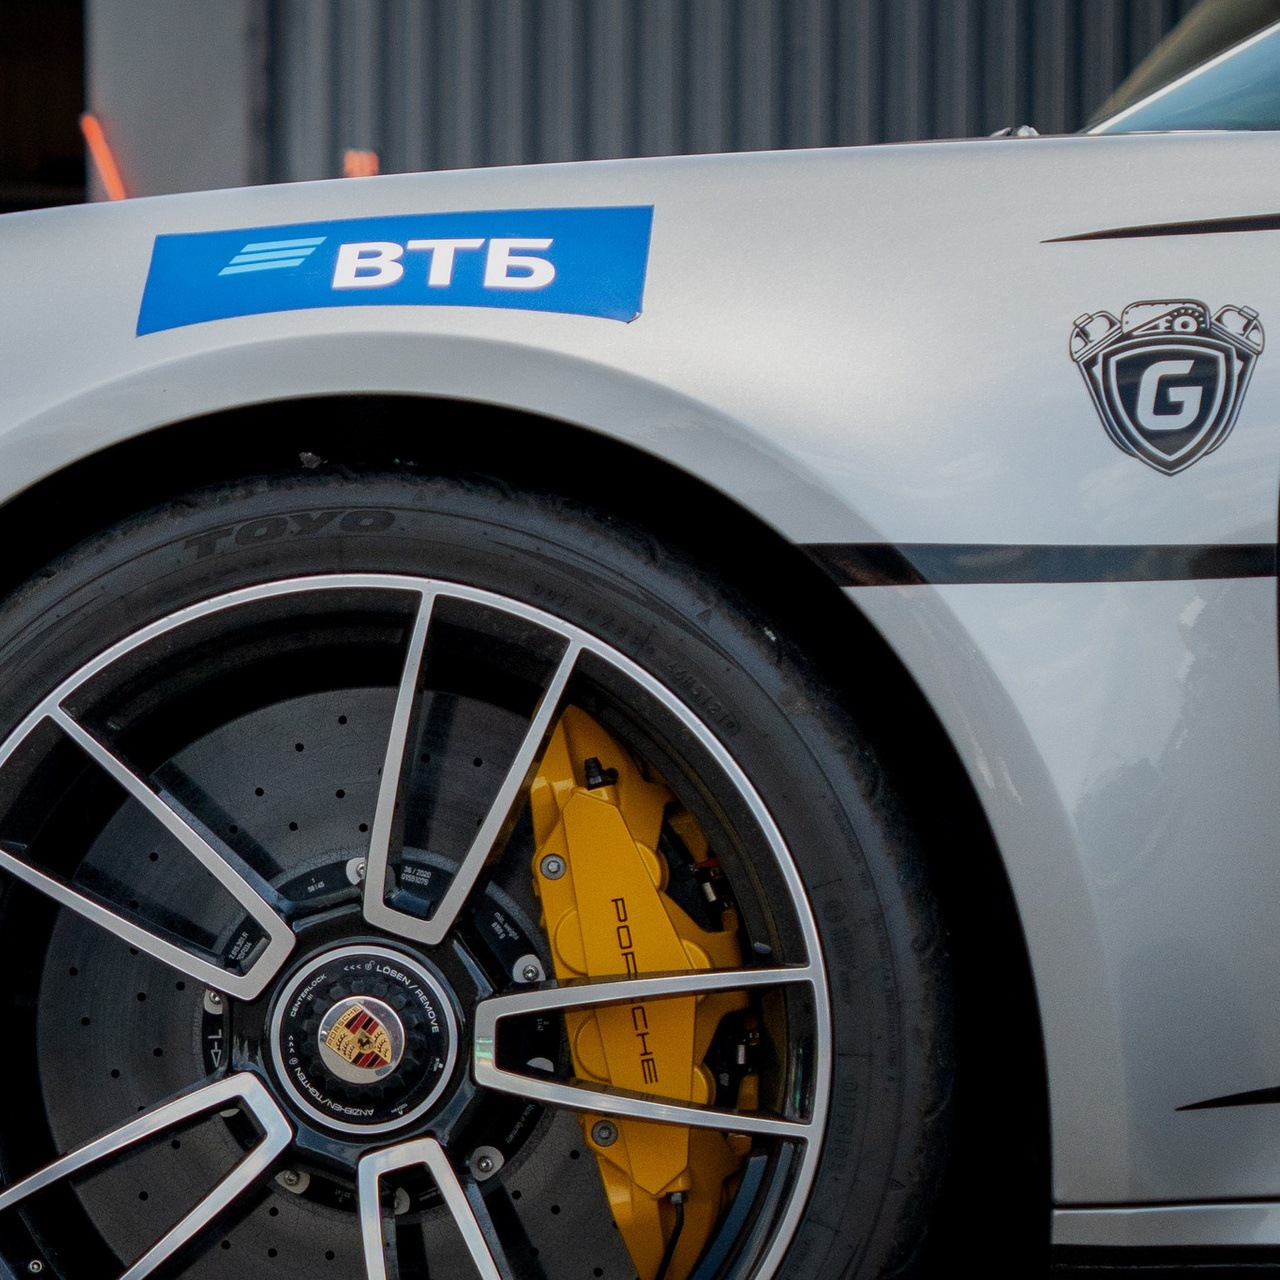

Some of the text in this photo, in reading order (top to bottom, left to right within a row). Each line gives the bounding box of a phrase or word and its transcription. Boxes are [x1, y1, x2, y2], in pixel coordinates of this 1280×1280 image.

[332, 238, 556, 290] ВТБ
[1137, 359, 1203, 431] G
[181, 509, 396, 562] TOYO
[290, 973, 328, 1018] CENTERLOCK
[376, 963, 411, 987] LÖSEN
[415, 988, 440, 1033] REMOVE
[611, 897, 659, 1085] PORCHE
[327, 1006, 361, 1046] PORSCHE
